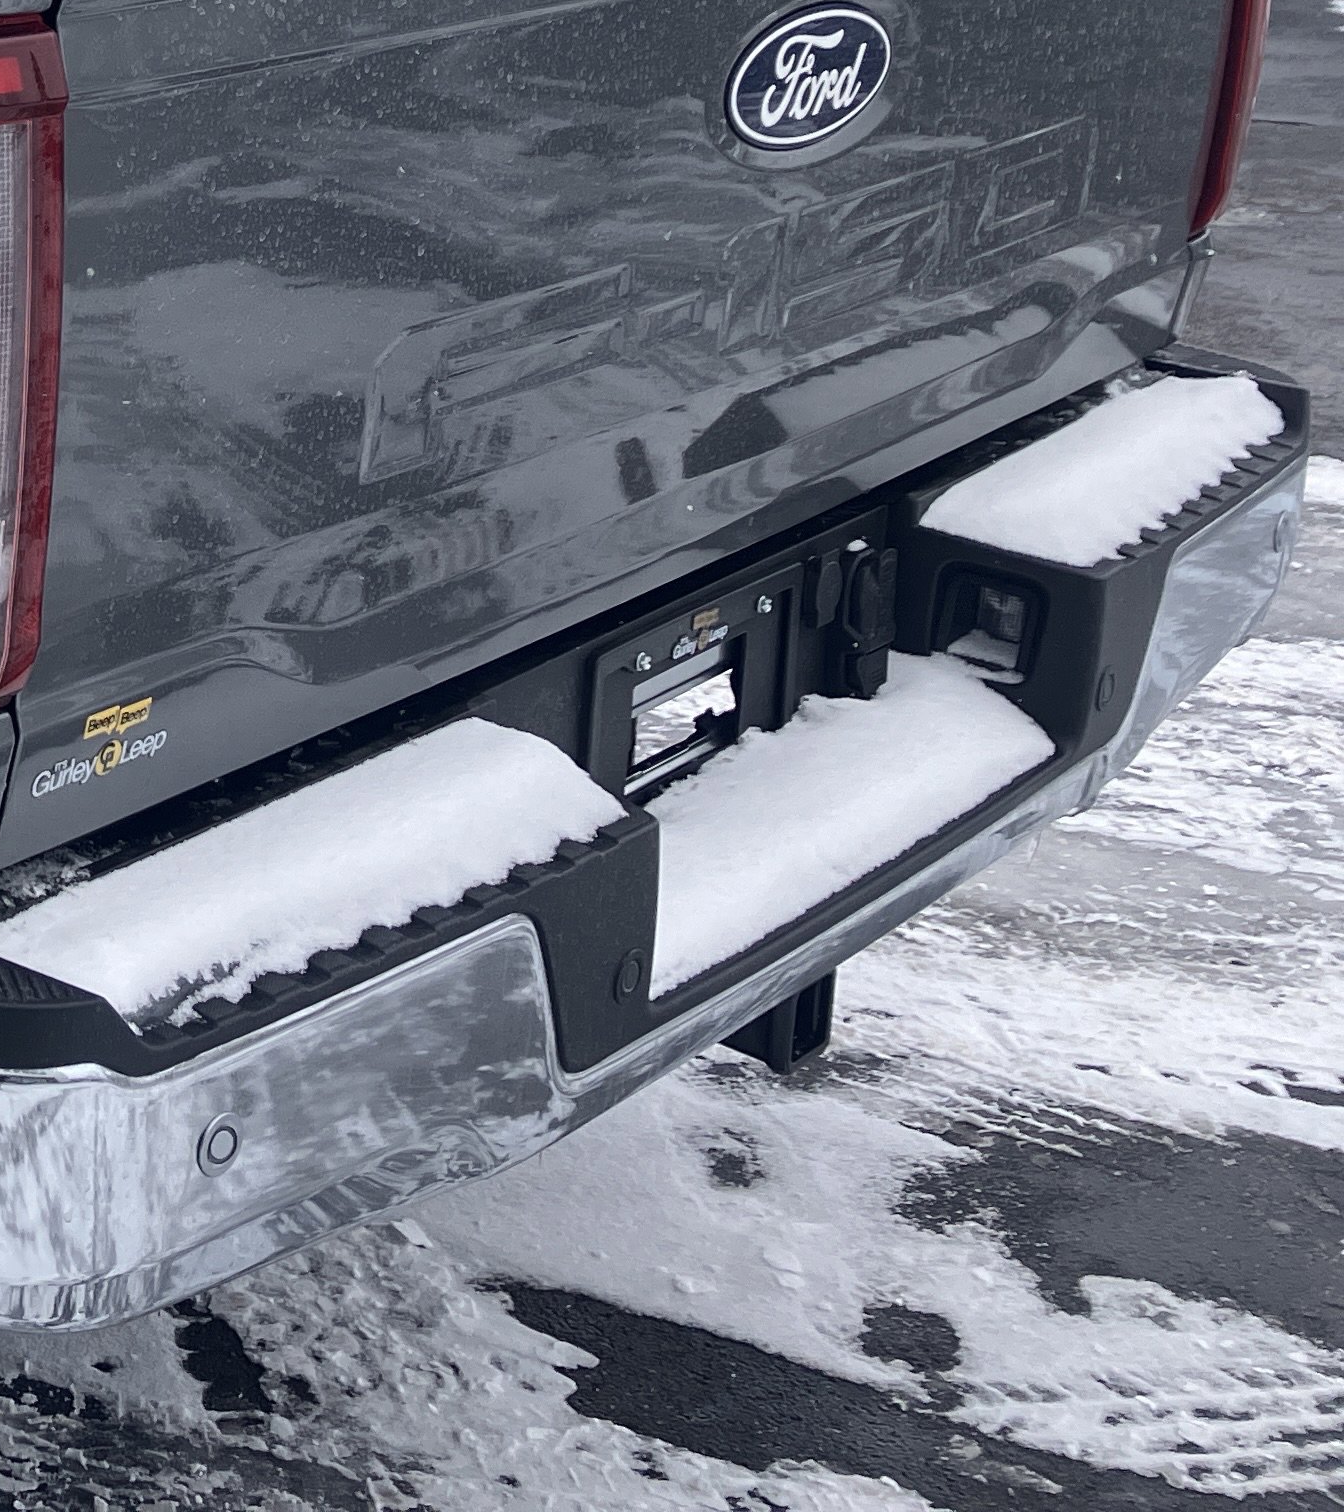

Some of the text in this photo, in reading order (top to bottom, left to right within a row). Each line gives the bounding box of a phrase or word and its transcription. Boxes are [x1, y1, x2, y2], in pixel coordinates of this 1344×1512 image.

[760, 28, 868, 128] Ford
[31, 755, 99, 798] Gurley
[118, 730, 168, 765] Leep
